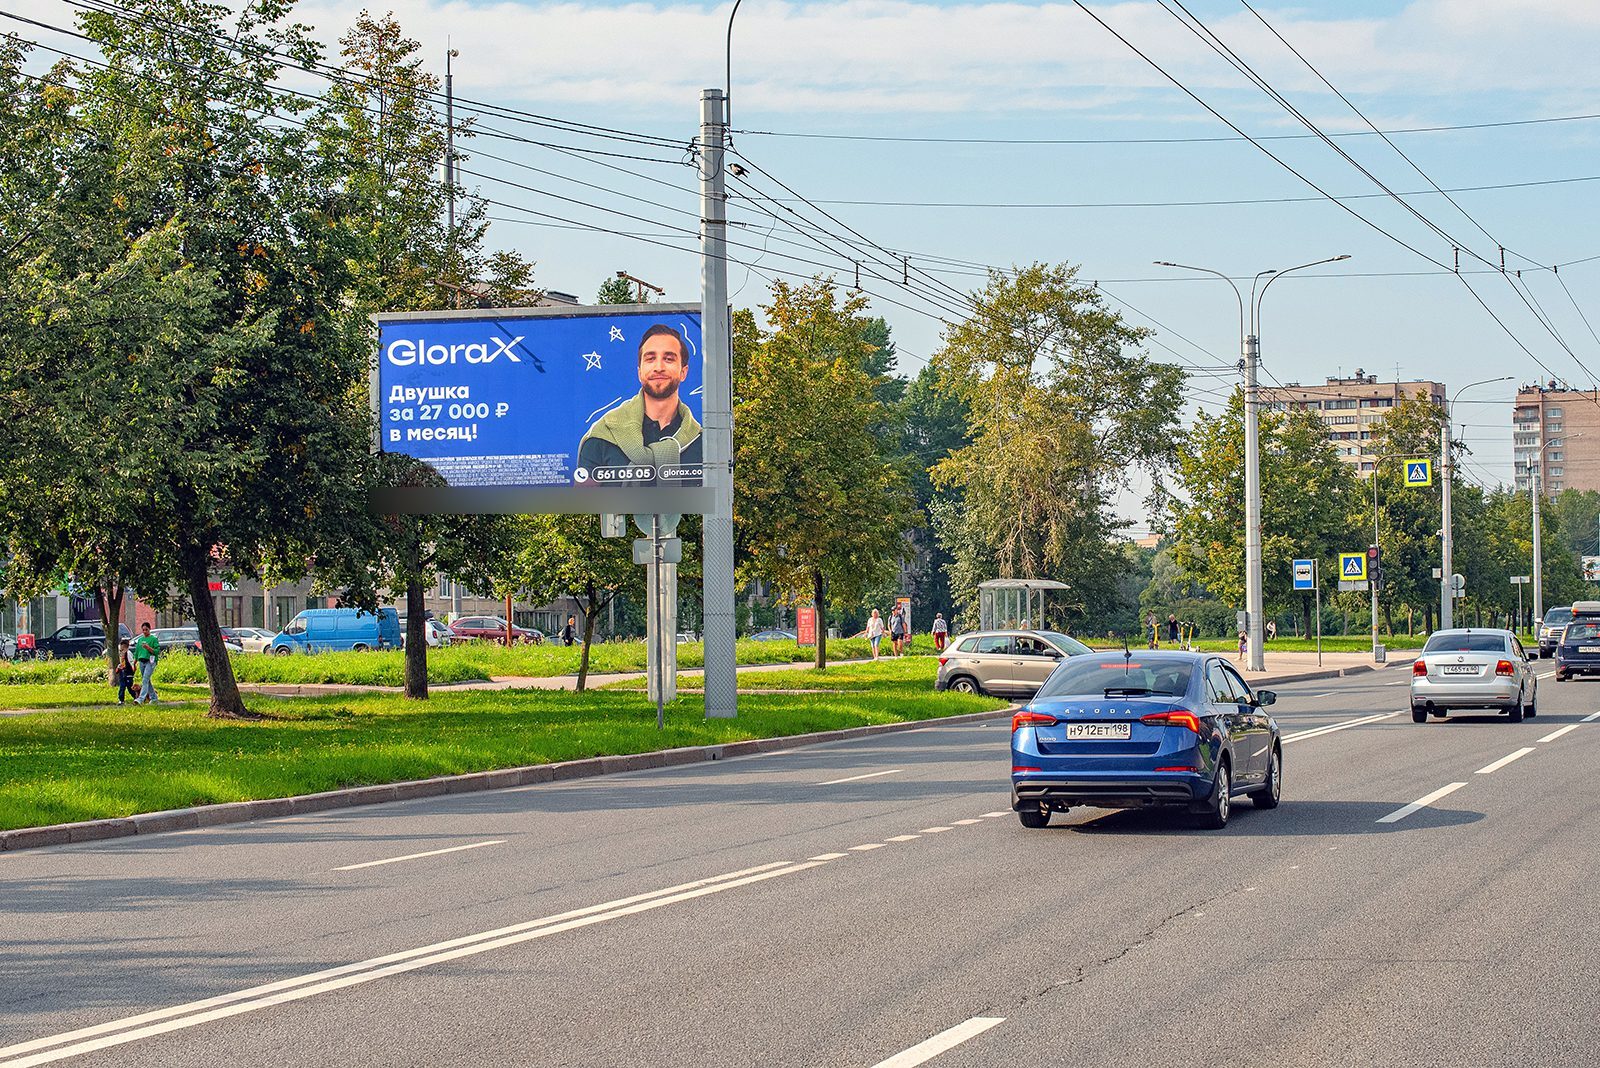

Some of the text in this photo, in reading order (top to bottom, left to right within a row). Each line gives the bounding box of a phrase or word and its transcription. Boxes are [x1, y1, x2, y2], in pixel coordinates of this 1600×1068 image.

[387, 336, 525, 366] GloraX
[388, 385, 470, 405] Двушка
[389, 402, 510, 421] за 27 000 ₽
[389, 424, 478, 442] в месяц!
[597, 468, 651, 481] 561 05 05
[663, 468, 703, 478] glorax.co
